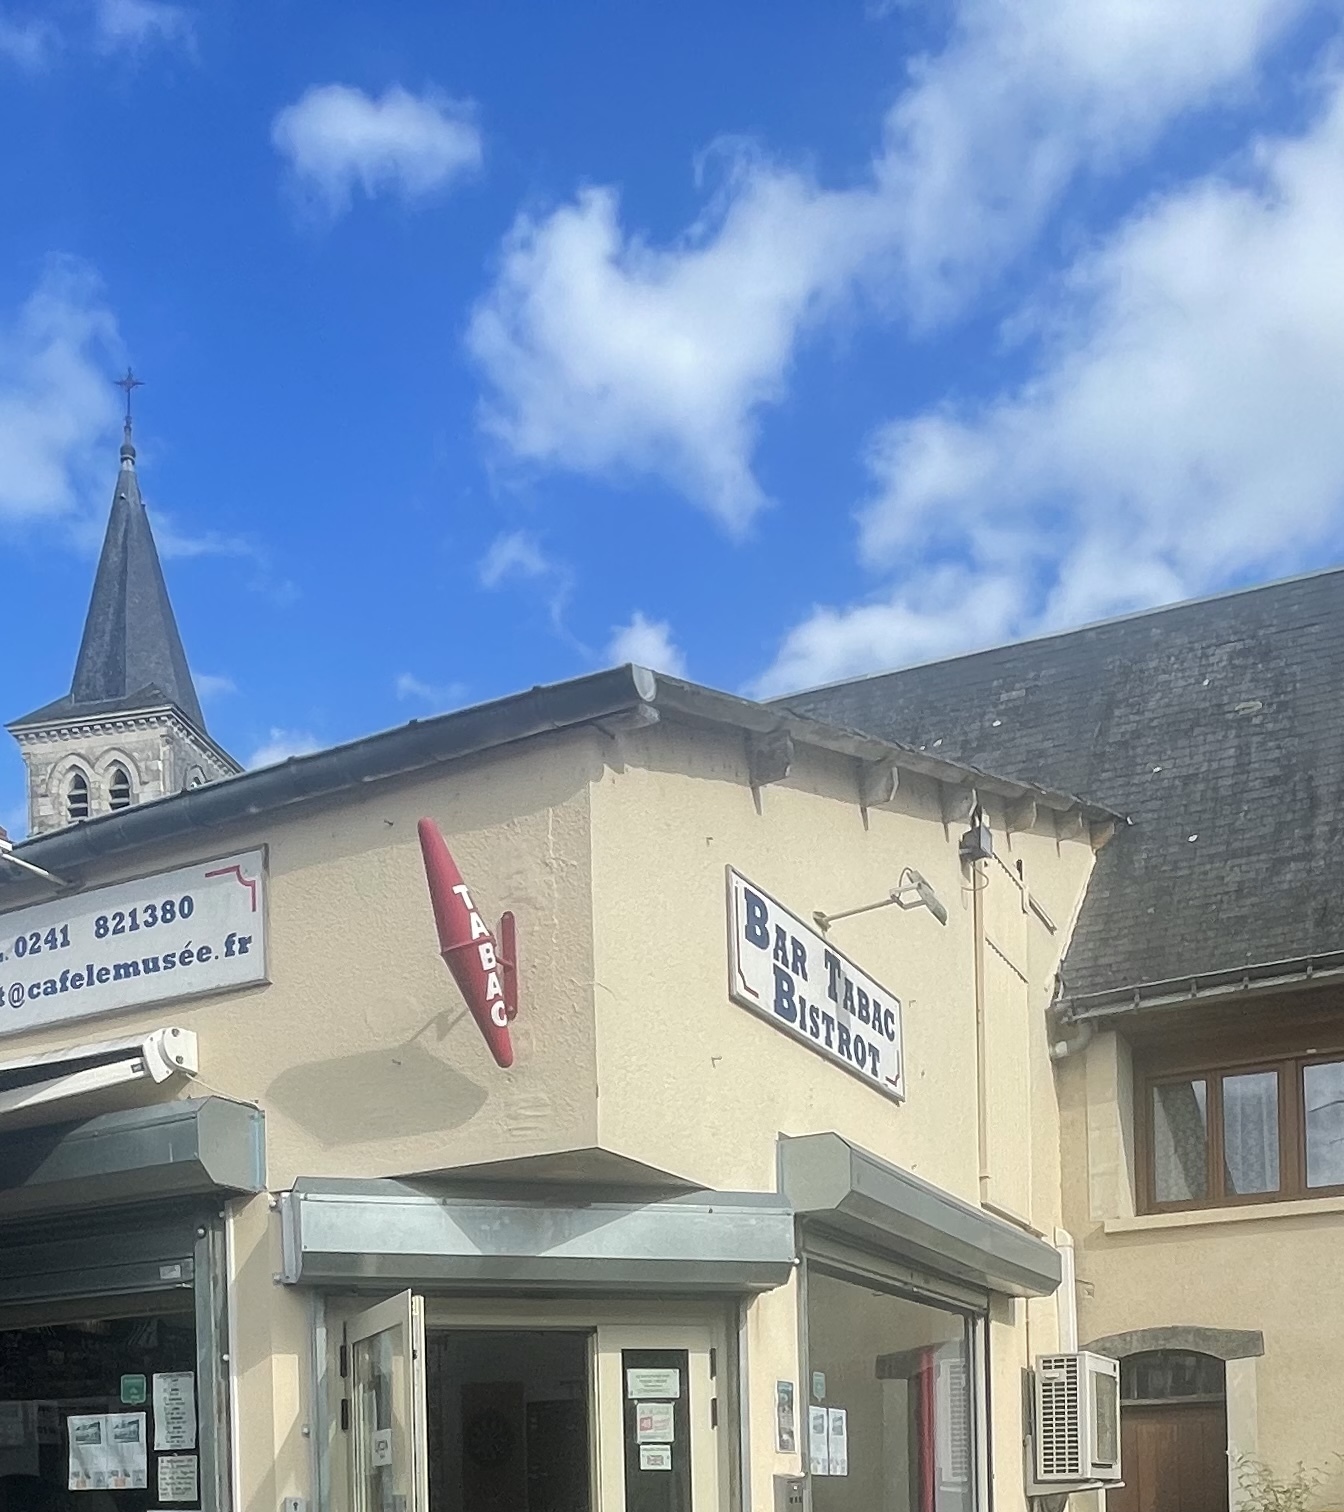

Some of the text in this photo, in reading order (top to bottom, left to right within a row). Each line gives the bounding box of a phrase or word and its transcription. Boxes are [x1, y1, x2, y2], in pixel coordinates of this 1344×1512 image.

[14, 924, 71, 957] 0241
[94, 895, 194, 939] 821380
[452, 884, 508, 1027] TABAC
[744, 887, 895, 1042] BAR TABAC
[773, 963, 881, 1078] BISTROT
